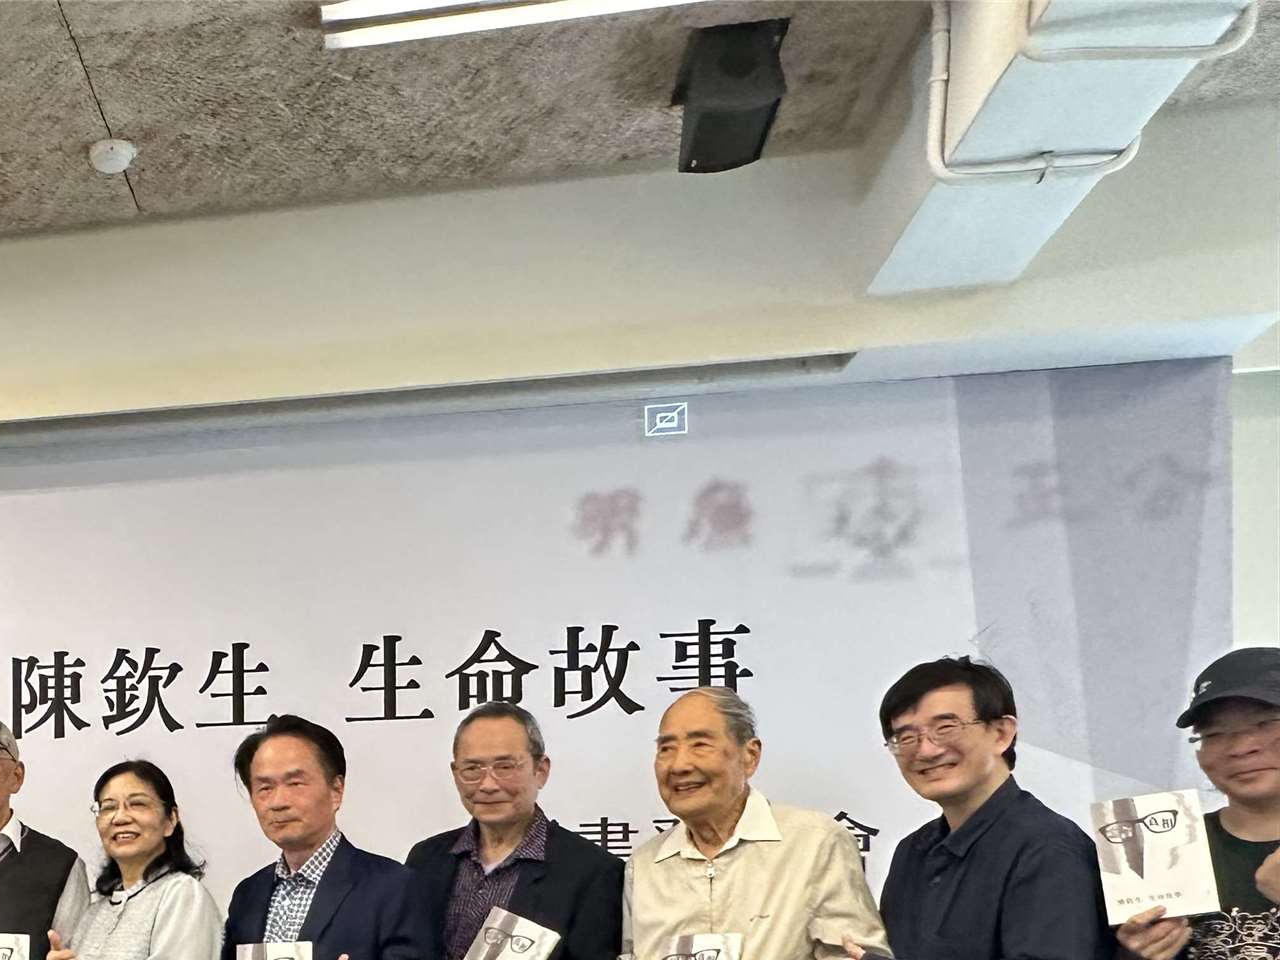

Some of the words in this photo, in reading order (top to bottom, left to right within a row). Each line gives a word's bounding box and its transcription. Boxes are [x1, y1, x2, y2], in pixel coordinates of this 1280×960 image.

[11, 642, 270, 739] 陳欽生
[345, 619, 754, 722] 生命故事
